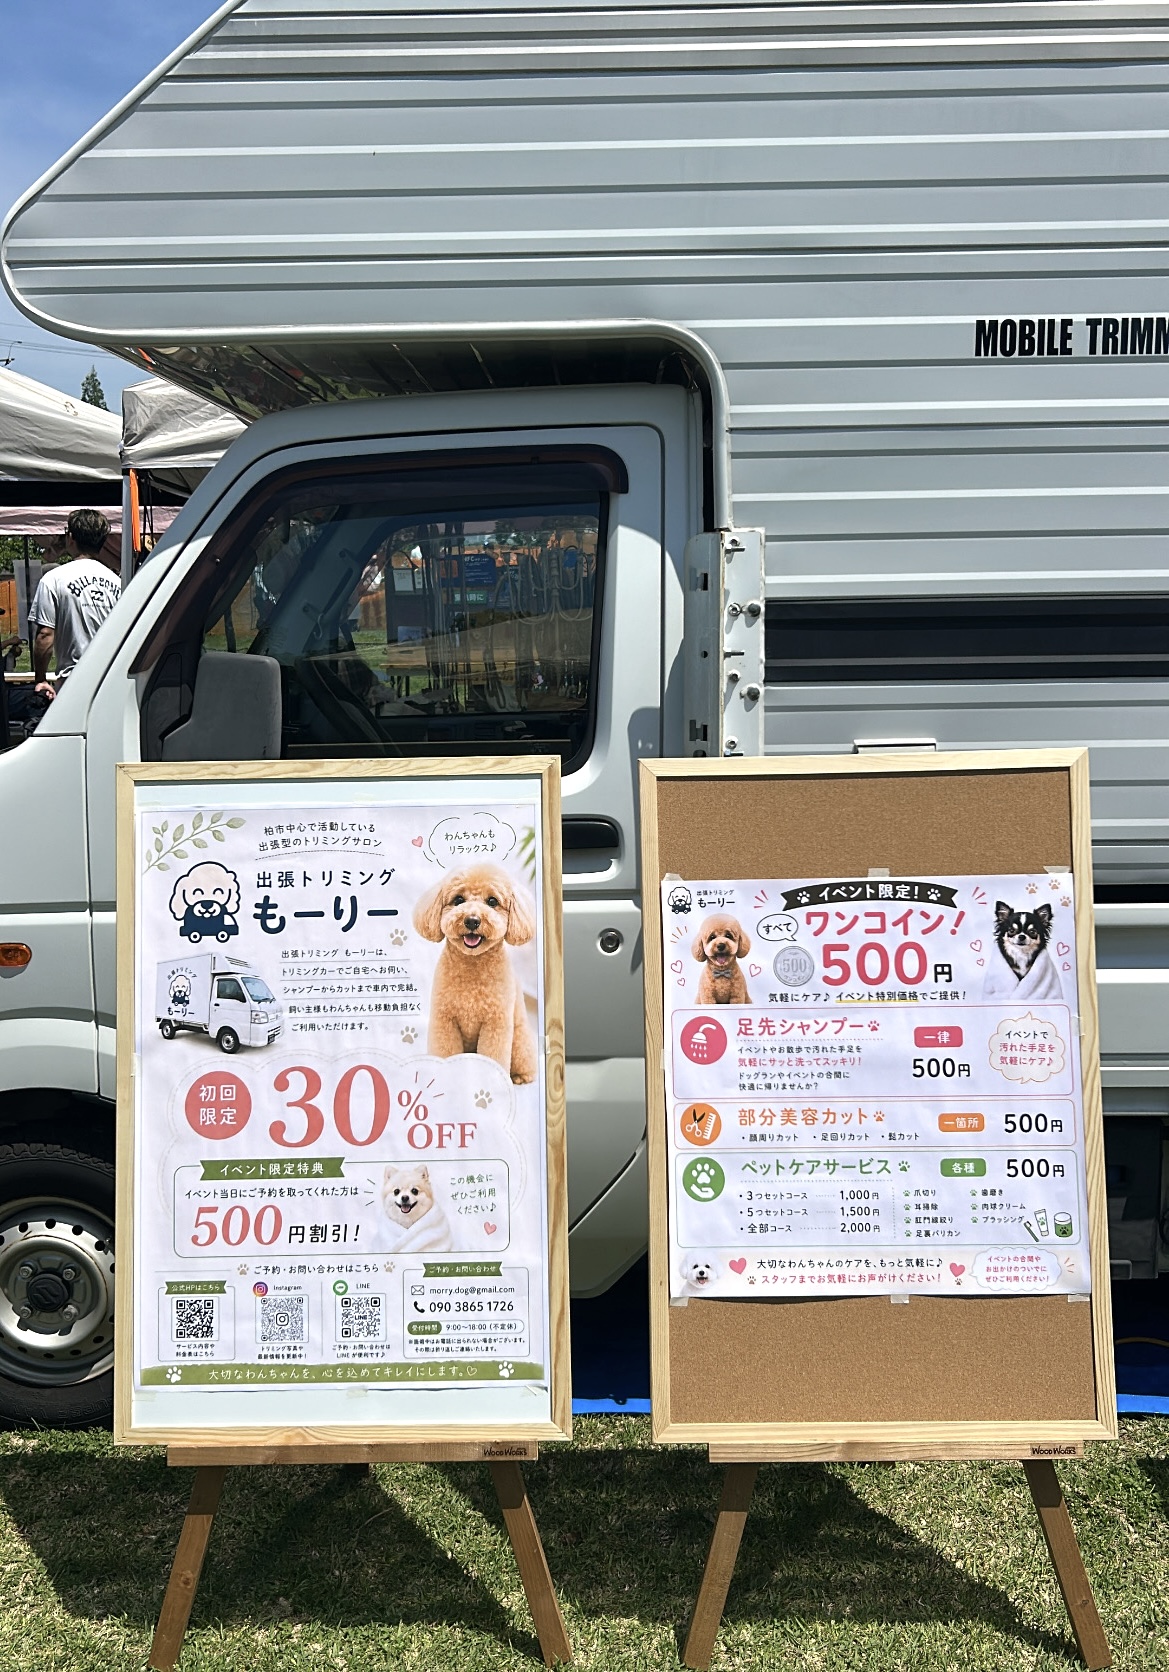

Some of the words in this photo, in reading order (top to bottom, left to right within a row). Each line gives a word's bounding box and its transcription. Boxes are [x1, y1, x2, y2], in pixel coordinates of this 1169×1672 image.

[975, 319, 1073, 357] MOBILE
[264, 822, 375, 835] 柏市中心で活動している
[445, 830, 495, 840] わんちゃんも
[259, 837, 381, 853] 出張型のトリミングサロン
[257, 869, 395, 888] 出張トリミング
[818, 882, 919, 901] イベント限定！
[698, 898, 735, 908] もーりー
[253, 895, 398, 934] もーりー
[806, 909, 965, 936] ワンコイン！
[763, 923, 791, 934] すべて
[282, 950, 338, 958] 出張トリミング
[783, 958, 807, 973] 500
[822, 942, 952, 986] 500円
[283, 966, 407, 976] トリミングカーでご自宅へお伺い、
[284, 984, 417, 993] シャンプーからカットまで車内で完結。
[835, 991, 967, 1003] イベント特別価格でご提供！
[289, 1003, 420, 1013] 飼い主様もわんちゃんも移動負担なく
[292, 1023, 368, 1031] ご利用いただけます。
[737, 1017, 863, 1036] 足先シャンプー
[924, 1031, 950, 1043] 一律
[1006, 1031, 1048, 1039] イベントで
[738, 1045, 861, 1053] イベントやお散歩で汚れた手足を
[1000, 1043, 1055, 1052] 汚れた手足を
[739, 1057, 861, 1067] 気軽にサッと洗ってスッキリ！
[913, 1058, 970, 1077] 500円
[740, 1071, 849, 1079] ドッグランやイベントの合間に
[200, 1085, 237, 1101] 初回
[200, 1107, 236, 1125] 限定
[739, 1108, 867, 1126] 部分美容カット
[944, 1117, 978, 1128] 一箇所
[1005, 1114, 1062, 1133] 500円
[407, 1123, 477, 1149] OFF
[821, 1133, 869, 1141] 足回りカット
[221, 1162, 323, 1175] イベント限定特典
[742, 1158, 891, 1175] ペットケアサービス
[952, 1163, 974, 1173] 各種
[1007, 1159, 1064, 1177] 500円
[451, 1175, 492, 1185] この機会に
[185, 1187, 358, 1198] イベント当日にご予約を取ってくれた方は
[451, 1188, 495, 1200] ぜひご利用
[747, 1191, 807, 1200] 3つセットコース
[840, 1190, 879, 1200] 1,000円
[748, 1208, 808, 1216] 5つセットコース
[841, 1207, 879, 1216] 1,500円
[748, 1223, 791, 1233] 全部コース
[841, 1223, 880, 1232] 2,000円
[255, 1264, 378, 1274] ご予約・お問い合わせはこちら
[762, 1273, 940, 1283] スタッフまでお気軽にお声がけください！
[430, 1286, 514, 1295] morry.dog@gmail.com
[430, 1302, 450, 1312] 090
[455, 1302, 483, 1312] 3865
[487, 1301, 513, 1311] 1726
[411, 1324, 438, 1332] 受付時間
